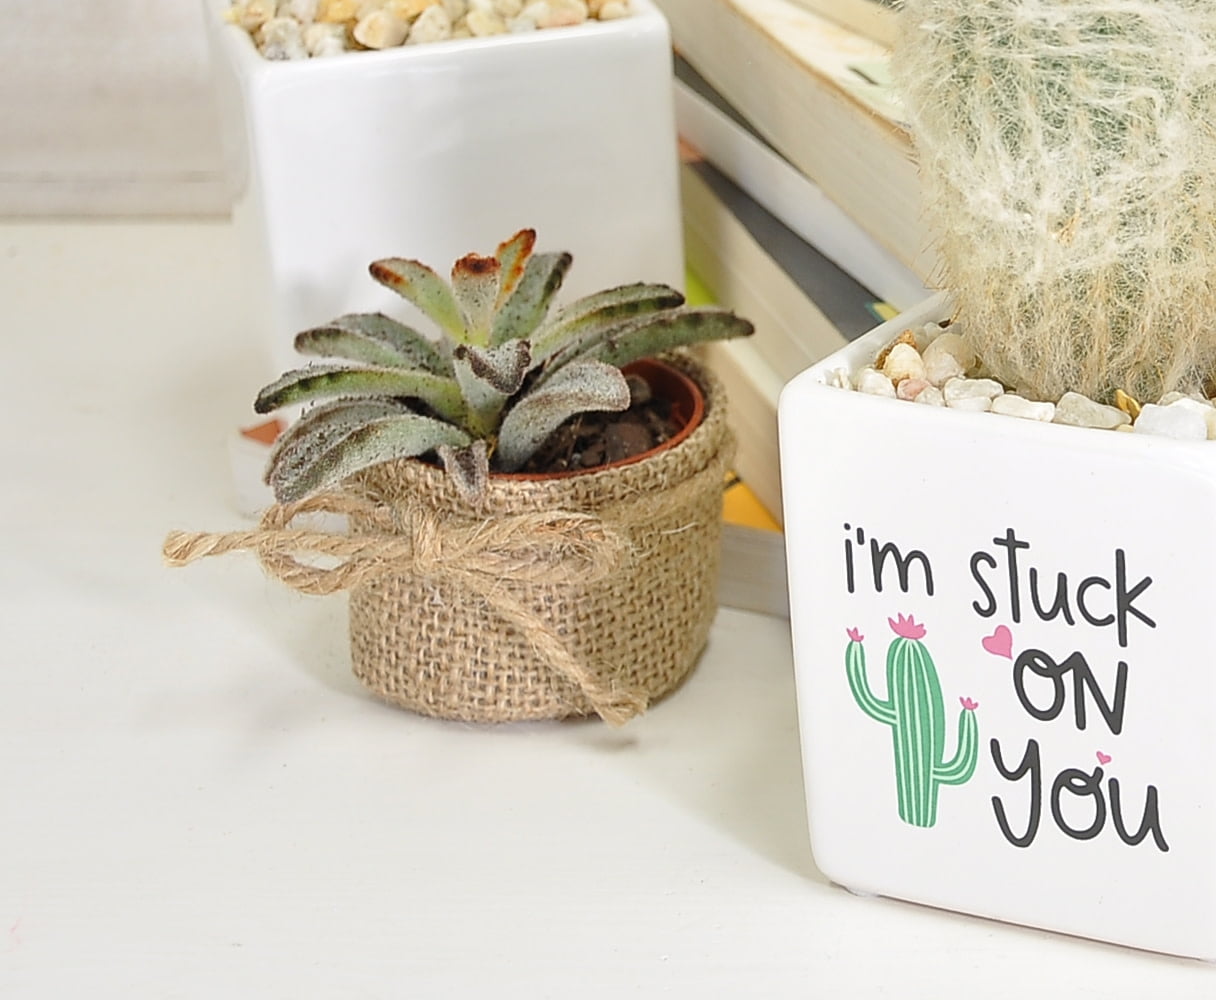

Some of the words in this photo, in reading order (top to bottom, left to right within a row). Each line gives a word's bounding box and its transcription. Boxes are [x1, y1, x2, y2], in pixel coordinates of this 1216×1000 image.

[844, 522, 934, 596] i'm
[969, 527, 1157, 648] stuck
[1012, 648, 1129, 736] ON
[989, 737, 1170, 853] you
